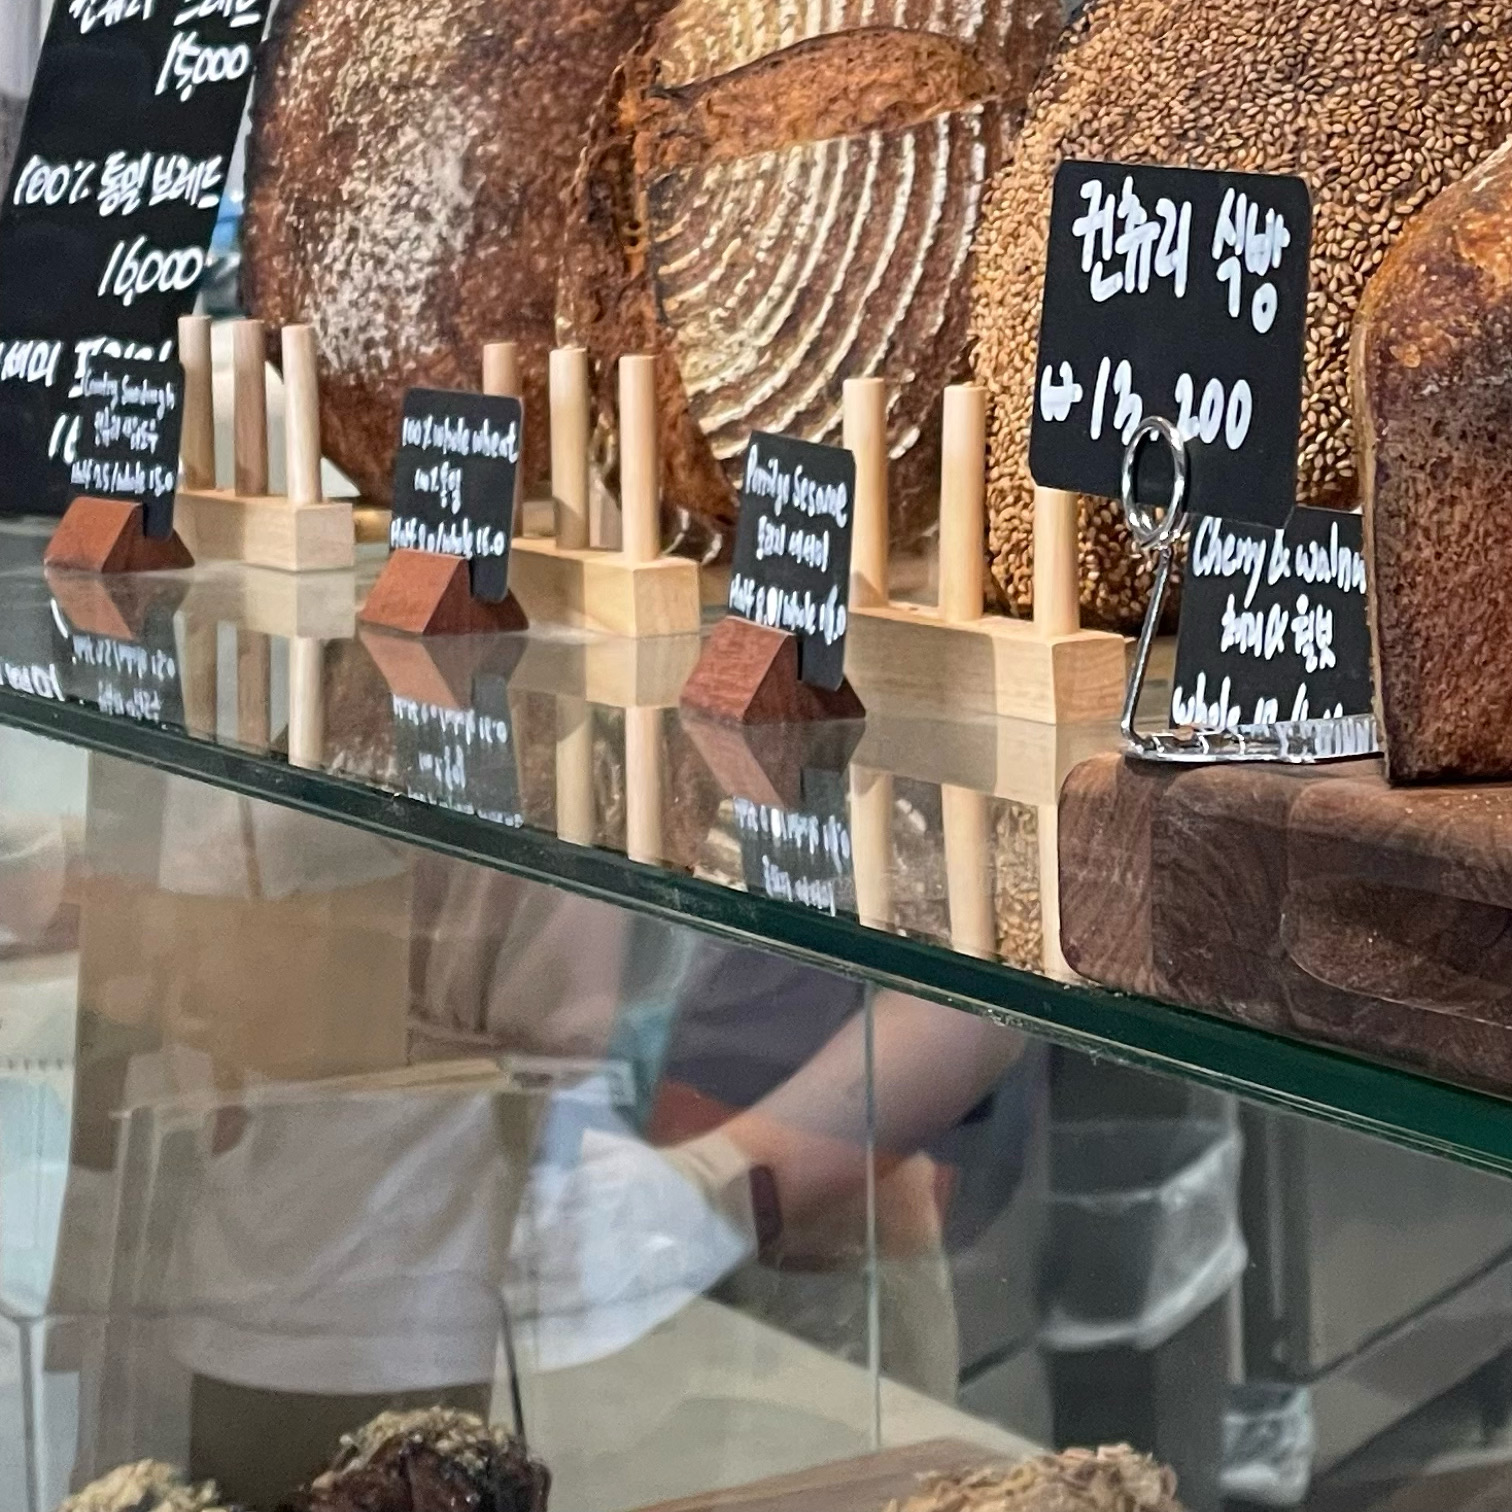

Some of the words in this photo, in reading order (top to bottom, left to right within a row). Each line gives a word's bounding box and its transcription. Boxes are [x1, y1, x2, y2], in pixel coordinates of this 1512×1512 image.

[154, 31, 250, 101] 15,000
[13, 154, 95, 205] 100%
[98, 151, 151, 217] 통밀
[149, 155, 223, 209] 브레드
[98, 235, 204, 306] 16,000
[1072, 176, 1192, 302] 컨츄리
[1212, 187, 1290, 333] 식빵
[472, 418, 519, 463] wheat
[1193, 516, 1266, 609] Cherry
[1295, 521, 1366, 594] walnu
